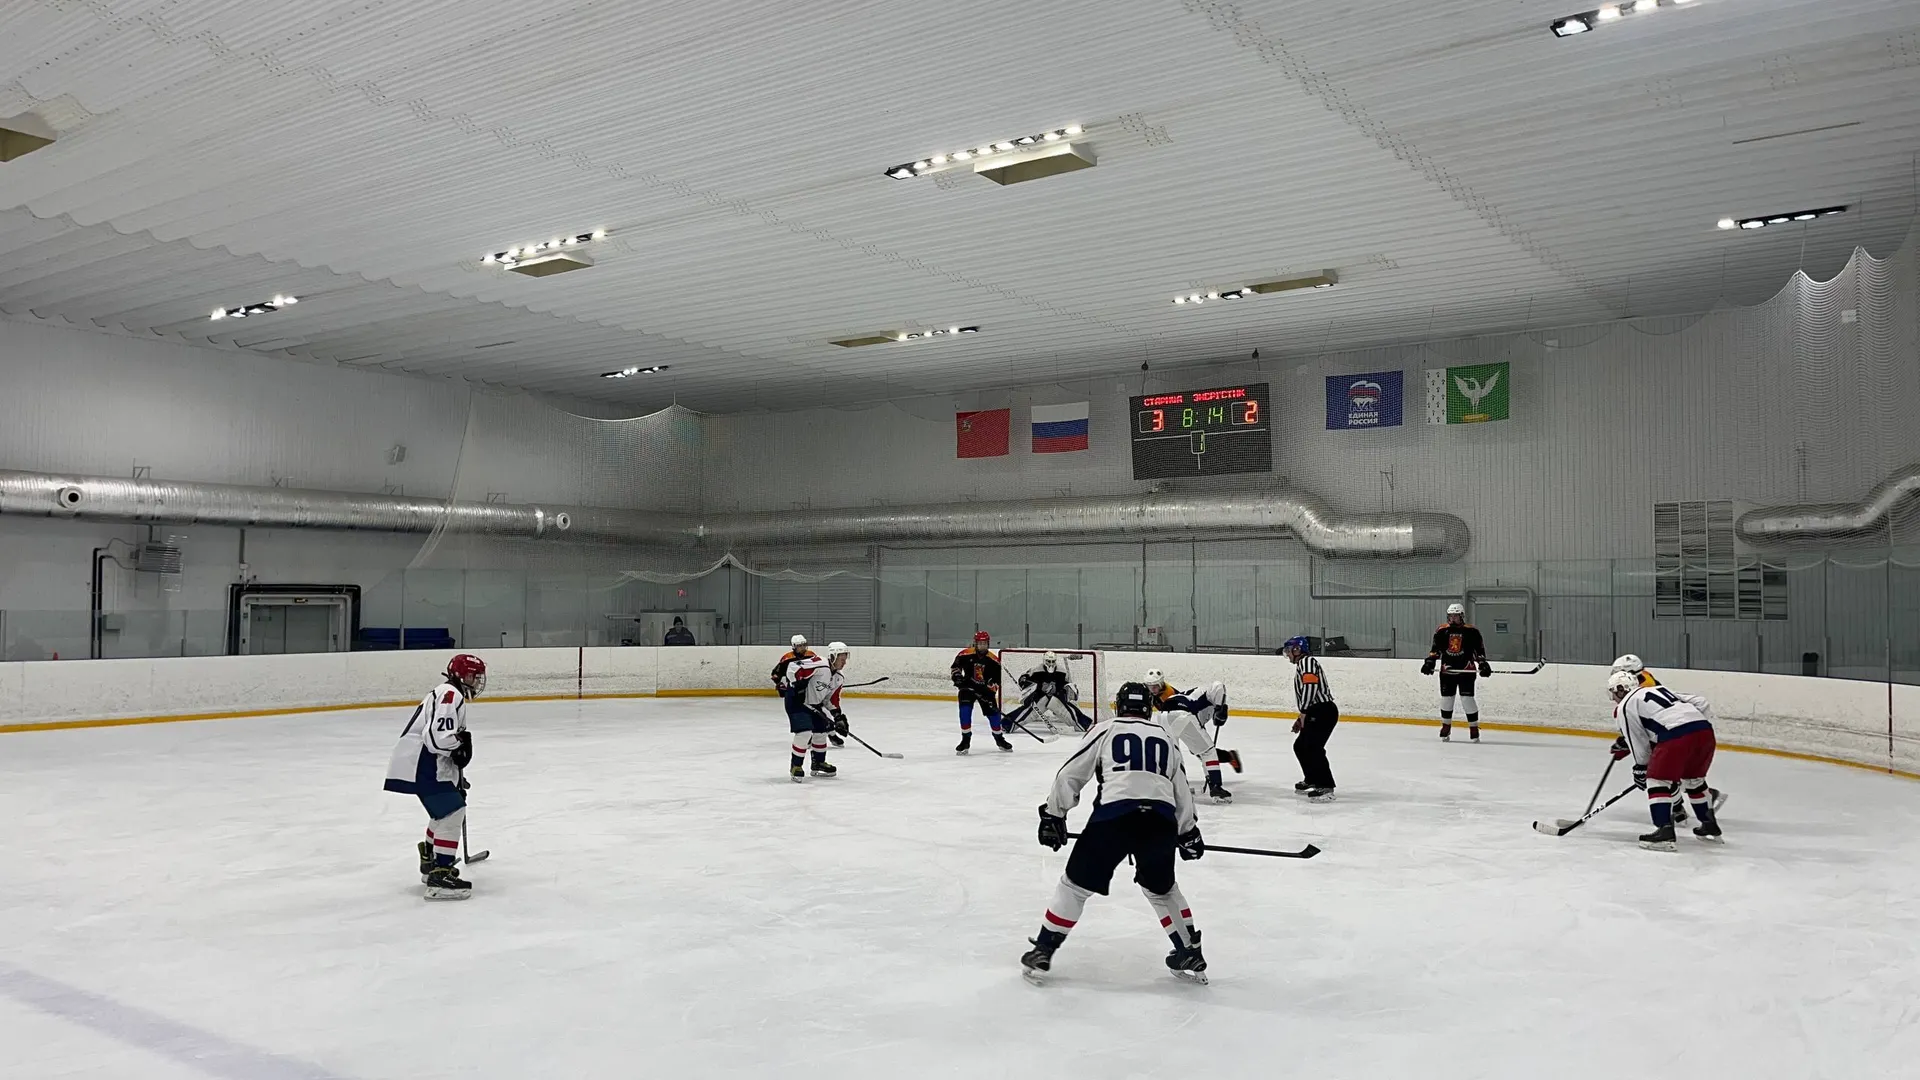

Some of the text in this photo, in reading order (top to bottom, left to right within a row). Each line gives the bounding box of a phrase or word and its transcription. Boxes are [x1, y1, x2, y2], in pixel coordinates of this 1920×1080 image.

[1244, 400, 1258, 422] 2
[1348, 411, 1379, 419] ЕДИНАЯ
[1152, 409, 1164, 432] 3
[1348, 418, 1378, 426] РОССИЯ
[437, 717, 455, 732] 20
[1111, 732, 1170, 778] 90
